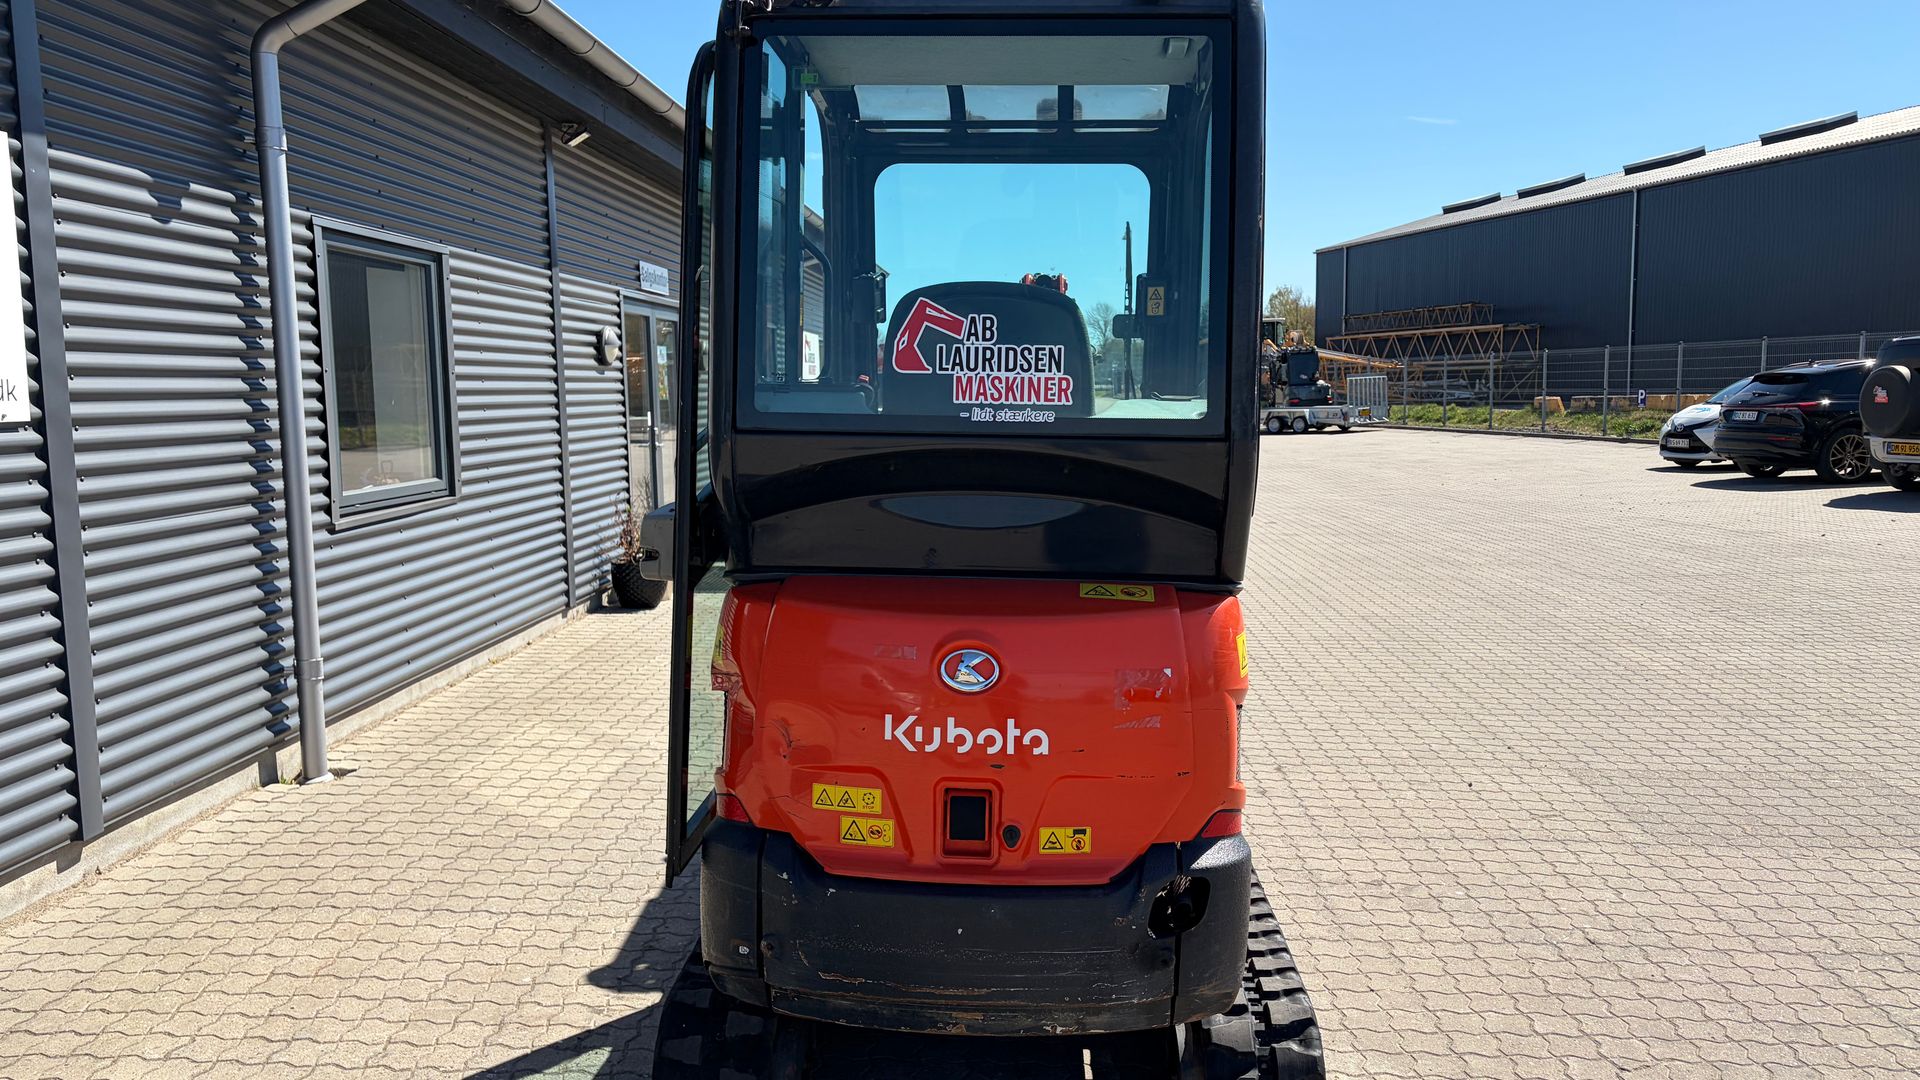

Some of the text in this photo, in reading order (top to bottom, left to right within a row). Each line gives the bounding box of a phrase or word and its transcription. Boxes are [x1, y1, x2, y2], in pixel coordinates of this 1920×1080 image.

[965, 315, 996, 343] AB
[937, 345, 1063, 373] LAURIDSEN
[954, 375, 1072, 403] MASKINER
[1638, 390, 1645, 403] P
[972, 407, 994, 421] lidt
[996, 408, 1055, 422] stærkere
[1900, 444, 1907, 452] 91
[1908, 445, 1919, 453] 956
[884, 713, 1049, 756] Kubota
